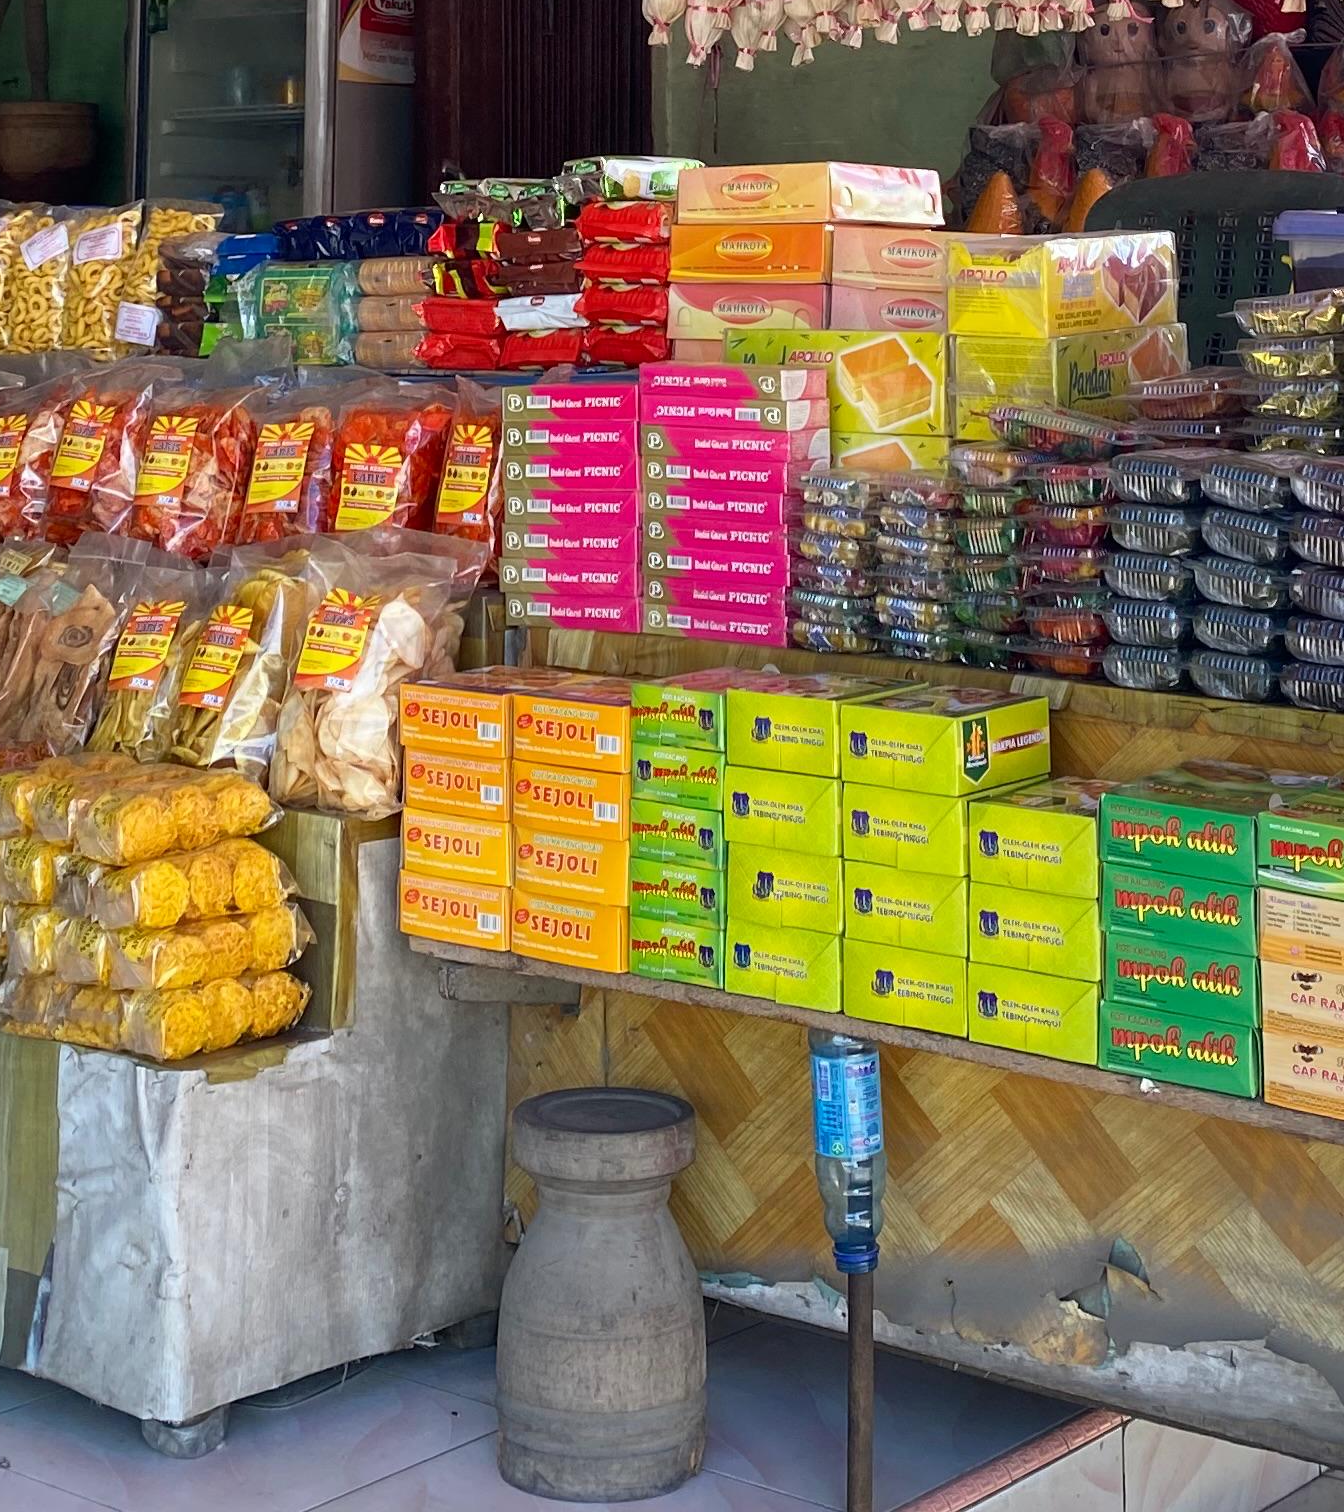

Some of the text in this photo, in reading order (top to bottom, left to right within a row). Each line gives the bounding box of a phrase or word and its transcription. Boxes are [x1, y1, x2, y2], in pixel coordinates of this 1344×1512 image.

[727, 181, 773, 192] MAHKOTA
[721, 240, 768, 251] MAHKOTA
[887, 246, 938, 259] MAHKOTA
[958, 268, 1007, 284] APOLLO
[717, 303, 766, 314] MAHKOTA
[887, 306, 937, 319] MAHKOTA
[788, 351, 834, 364] APOLLO
[1098, 350, 1127, 367] APOLLO
[654, 375, 691, 387] PICNIC
[1068, 349, 1113, 404] Pandan
[584, 397, 621, 408] PICNIC
[655, 405, 695, 417] PICNIC
[583, 432, 619, 443] PICNIC
[731, 438, 773, 451] PICNIC
[584, 466, 621, 477] PICNIC
[729, 470, 769, 483] PICNIC
[584, 502, 621, 513] PICNIC
[727, 501, 766, 514] PICNIC
[582, 537, 619, 548] PICNIC
[730, 531, 770, 544] PICNIC
[731, 561, 772, 575] PICNIC
[581, 572, 619, 584] PICNIC
[729, 592, 769, 606] PICNIC
[584, 607, 621, 619] PICNIC
[729, 621, 769, 636] PICNIC
[422, 707, 479, 729] SEJOLI
[535, 719, 596, 742] SEJOLI
[427, 769, 481, 792] SEJOLI
[532, 785, 594, 810] SEJOLI
[424, 833, 480, 857] SEJOLI
[535, 850, 598, 876] SEJOLI
[422, 895, 478, 920] SEJOLI
[531, 914, 591, 941] SEJOLI
[1291, 992, 1315, 1006] CAP
[1292, 1064, 1316, 1077] CAP
